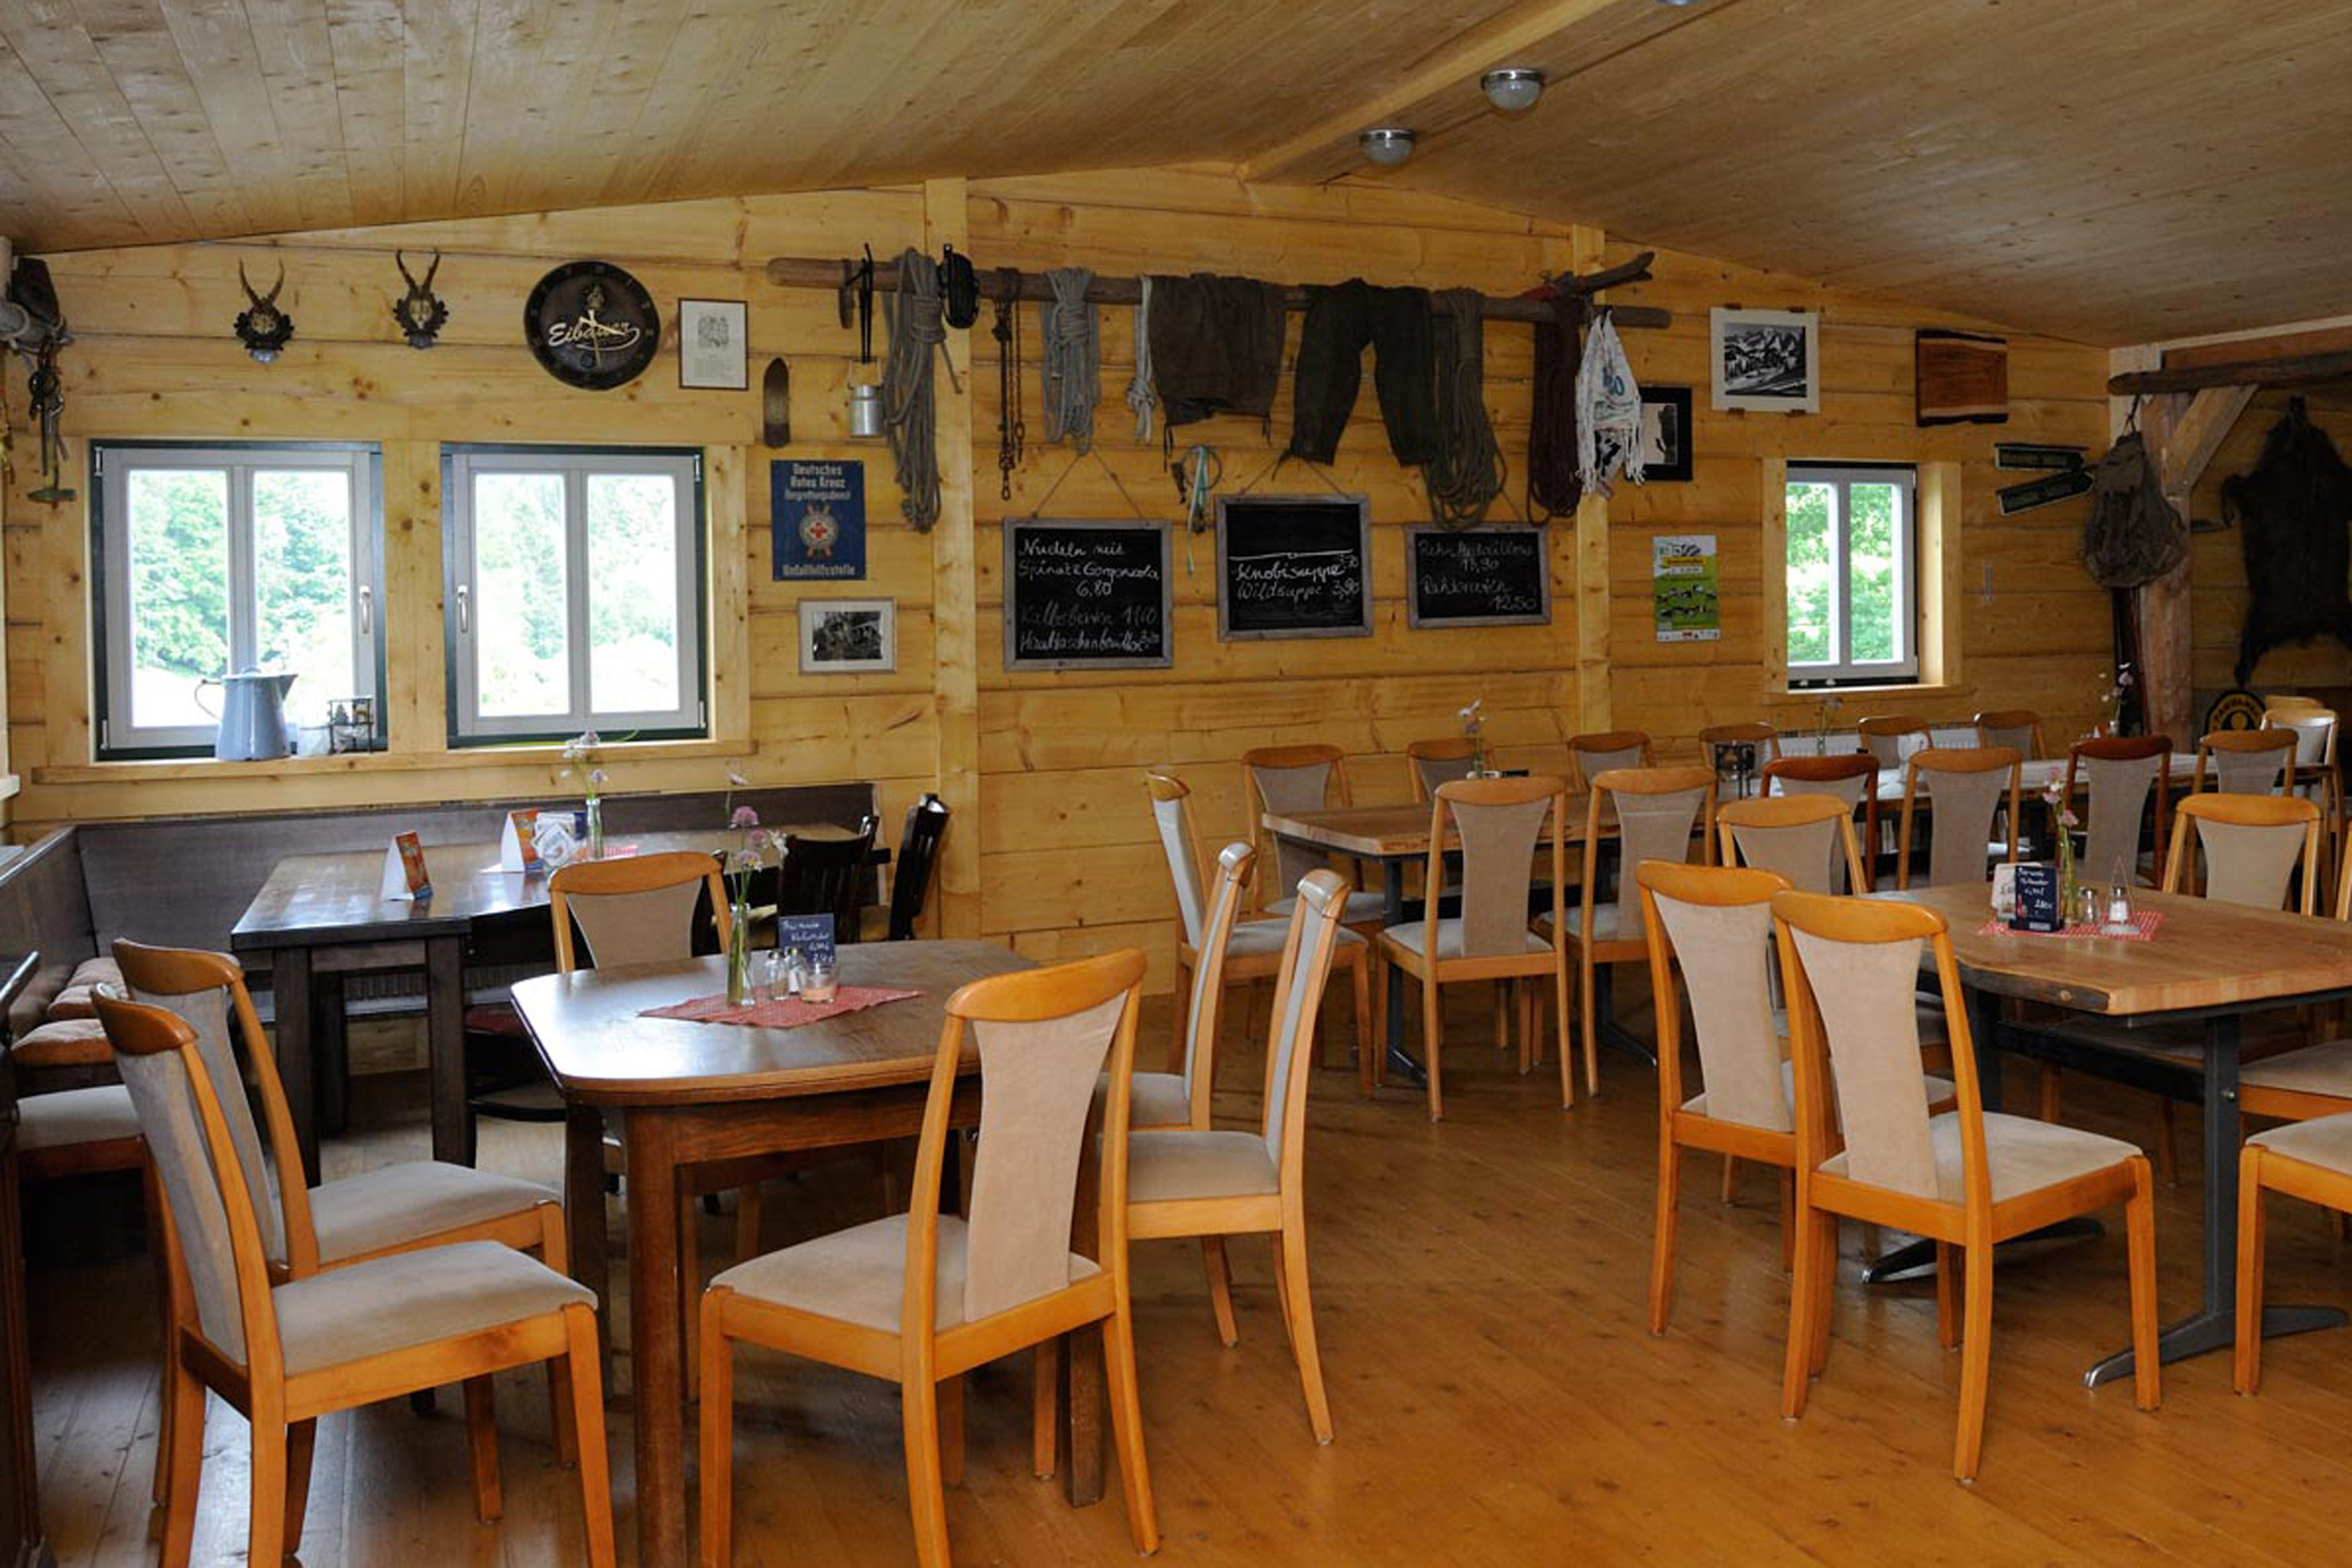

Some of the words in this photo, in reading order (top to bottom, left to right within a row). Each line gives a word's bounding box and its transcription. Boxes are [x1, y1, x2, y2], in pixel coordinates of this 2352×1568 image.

[793, 463, 842, 475] Deutsches
[790, 477, 816, 488] Rotes
[819, 477, 845, 488] Kreuz
[1019, 538, 1086, 557] Nudeln
[1238, 579, 1322, 603] Wildsuppe
